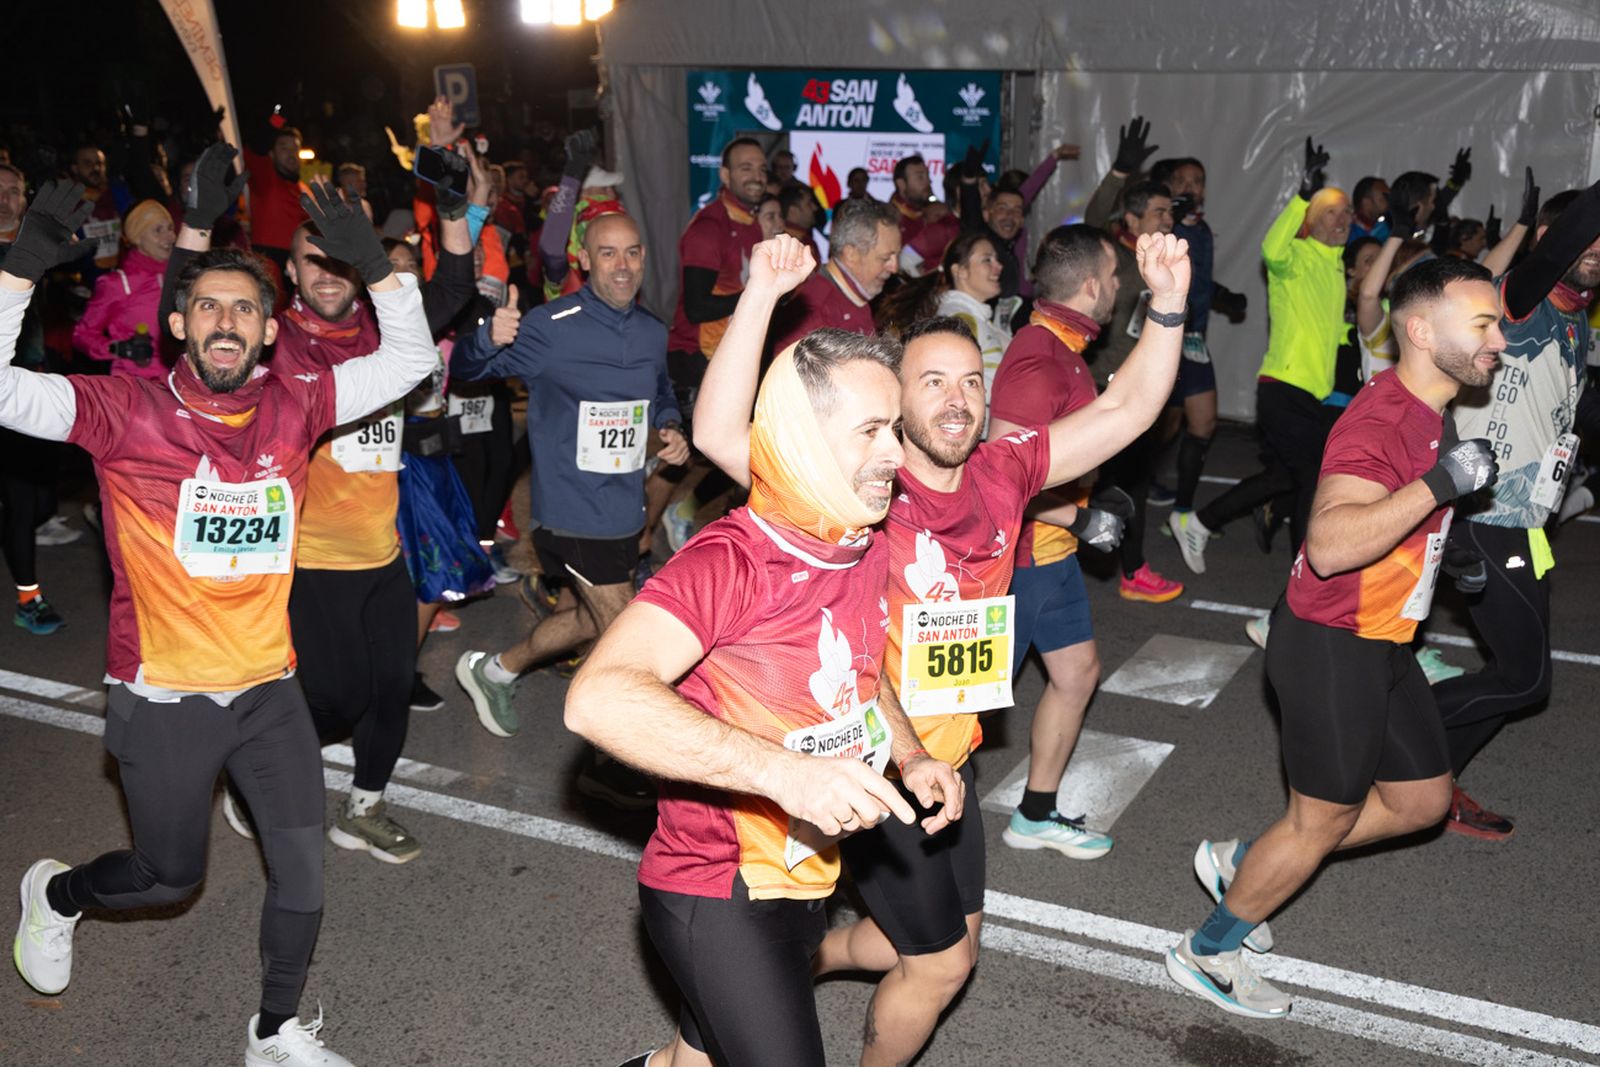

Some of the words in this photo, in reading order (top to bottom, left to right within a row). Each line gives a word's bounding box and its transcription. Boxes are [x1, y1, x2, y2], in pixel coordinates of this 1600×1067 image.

[445, 72, 470, 121] P
[802, 79, 830, 103] 43
[829, 79, 878, 103] SAN
[796, 100, 874, 128] ANTÓN
[1502, 364, 1529, 388] TEN
[1496, 384, 1518, 404] GO
[589, 418, 604, 426] SAN
[1491, 403, 1511, 421] EL
[357, 420, 396, 445] 396
[598, 427, 636, 449] 1212
[1486, 420, 1508, 440] PO
[1490, 441, 1513, 460] ER
[1552, 448, 1569, 459] SAN
[193, 502, 218, 514] SAN
[209, 492, 245, 504] NOCHE
[247, 493, 259, 504] DE
[193, 515, 281, 545] 13234
[930, 615, 964, 627] NOCHE
[966, 613, 979, 625] DE
[917, 631, 940, 643] SAN
[942, 625, 979, 641] ANTÓN
[928, 639, 993, 678] 5815
[818, 730, 852, 754] NOCHE
[852, 724, 864, 741] DE
